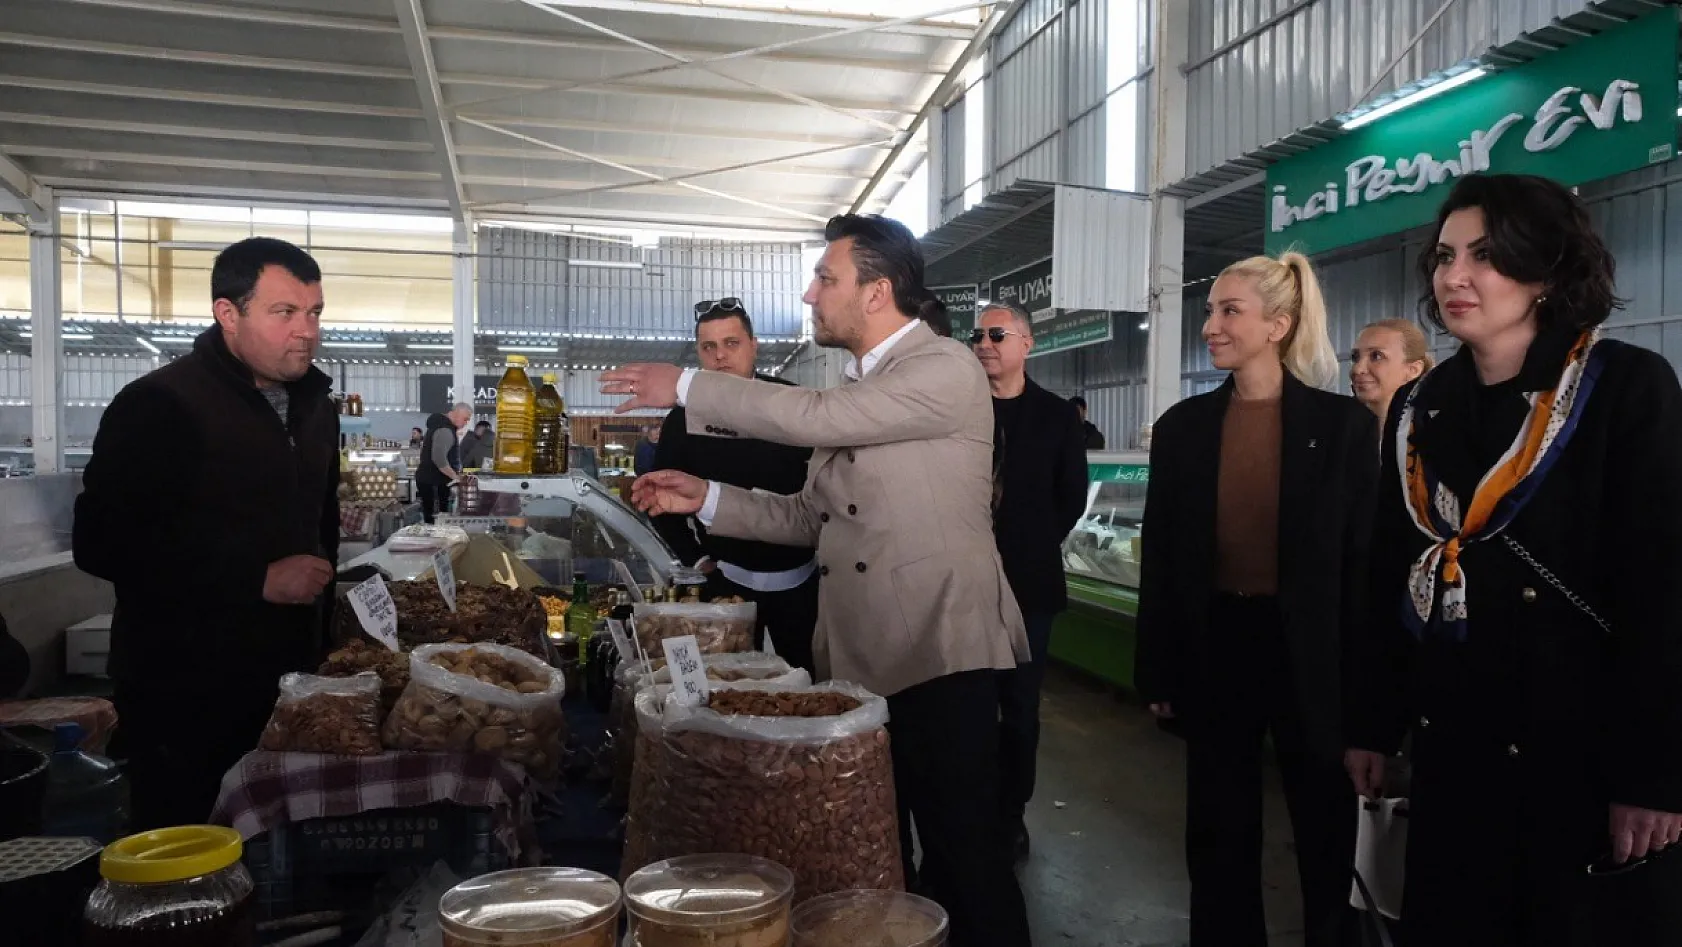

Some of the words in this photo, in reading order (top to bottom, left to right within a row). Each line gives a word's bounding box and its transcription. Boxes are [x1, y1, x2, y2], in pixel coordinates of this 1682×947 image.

[1271, 182, 1338, 232] İnci
[1345, 112, 1522, 206] Peynir
[1524, 79, 1643, 152] Evi
[946, 290, 976, 303] UYAR
